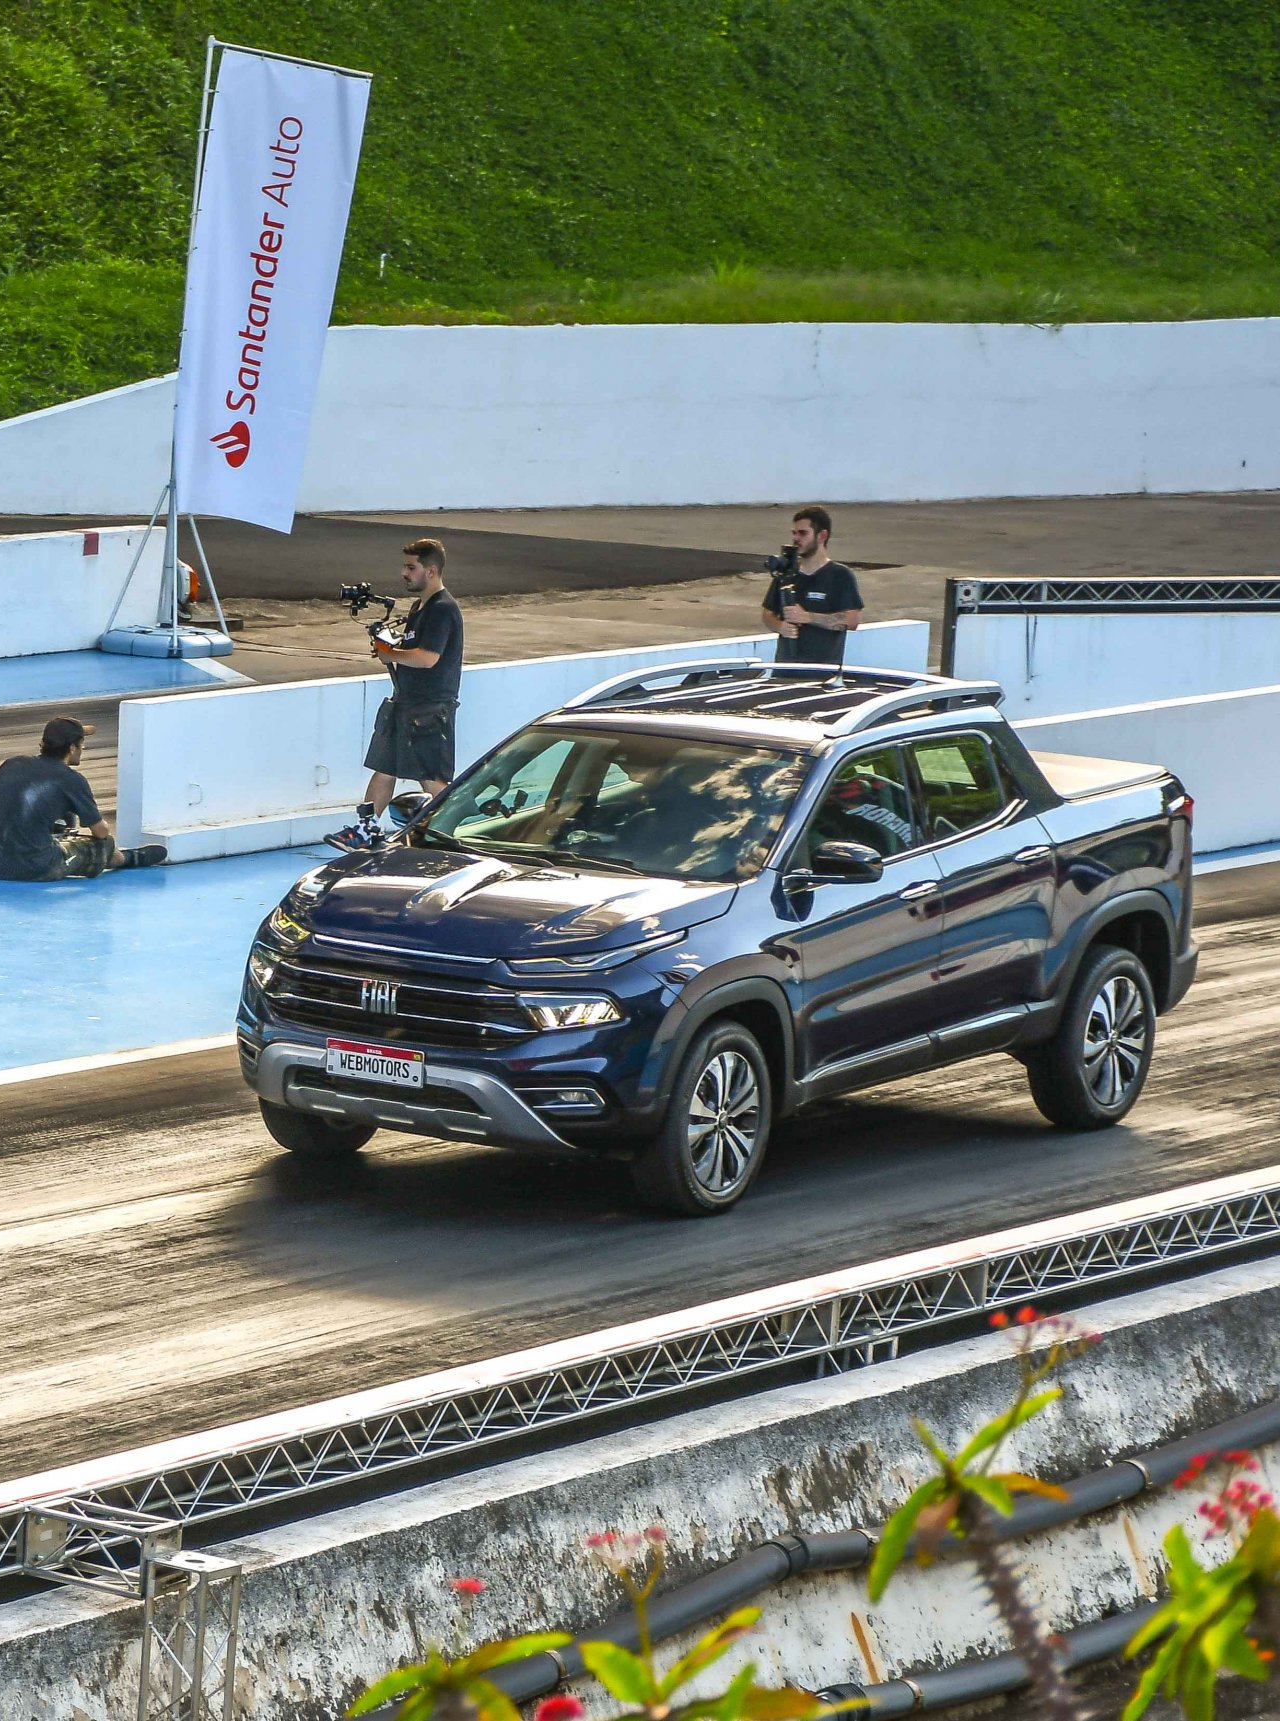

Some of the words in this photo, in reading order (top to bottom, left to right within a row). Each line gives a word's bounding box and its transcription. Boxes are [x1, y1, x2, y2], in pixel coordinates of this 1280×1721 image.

[225, 211, 285, 415] Santander
[261, 115, 303, 208] Auto
[361, 979, 402, 1015] FIAT
[340, 1052, 410, 1079] WEBMOTORS
